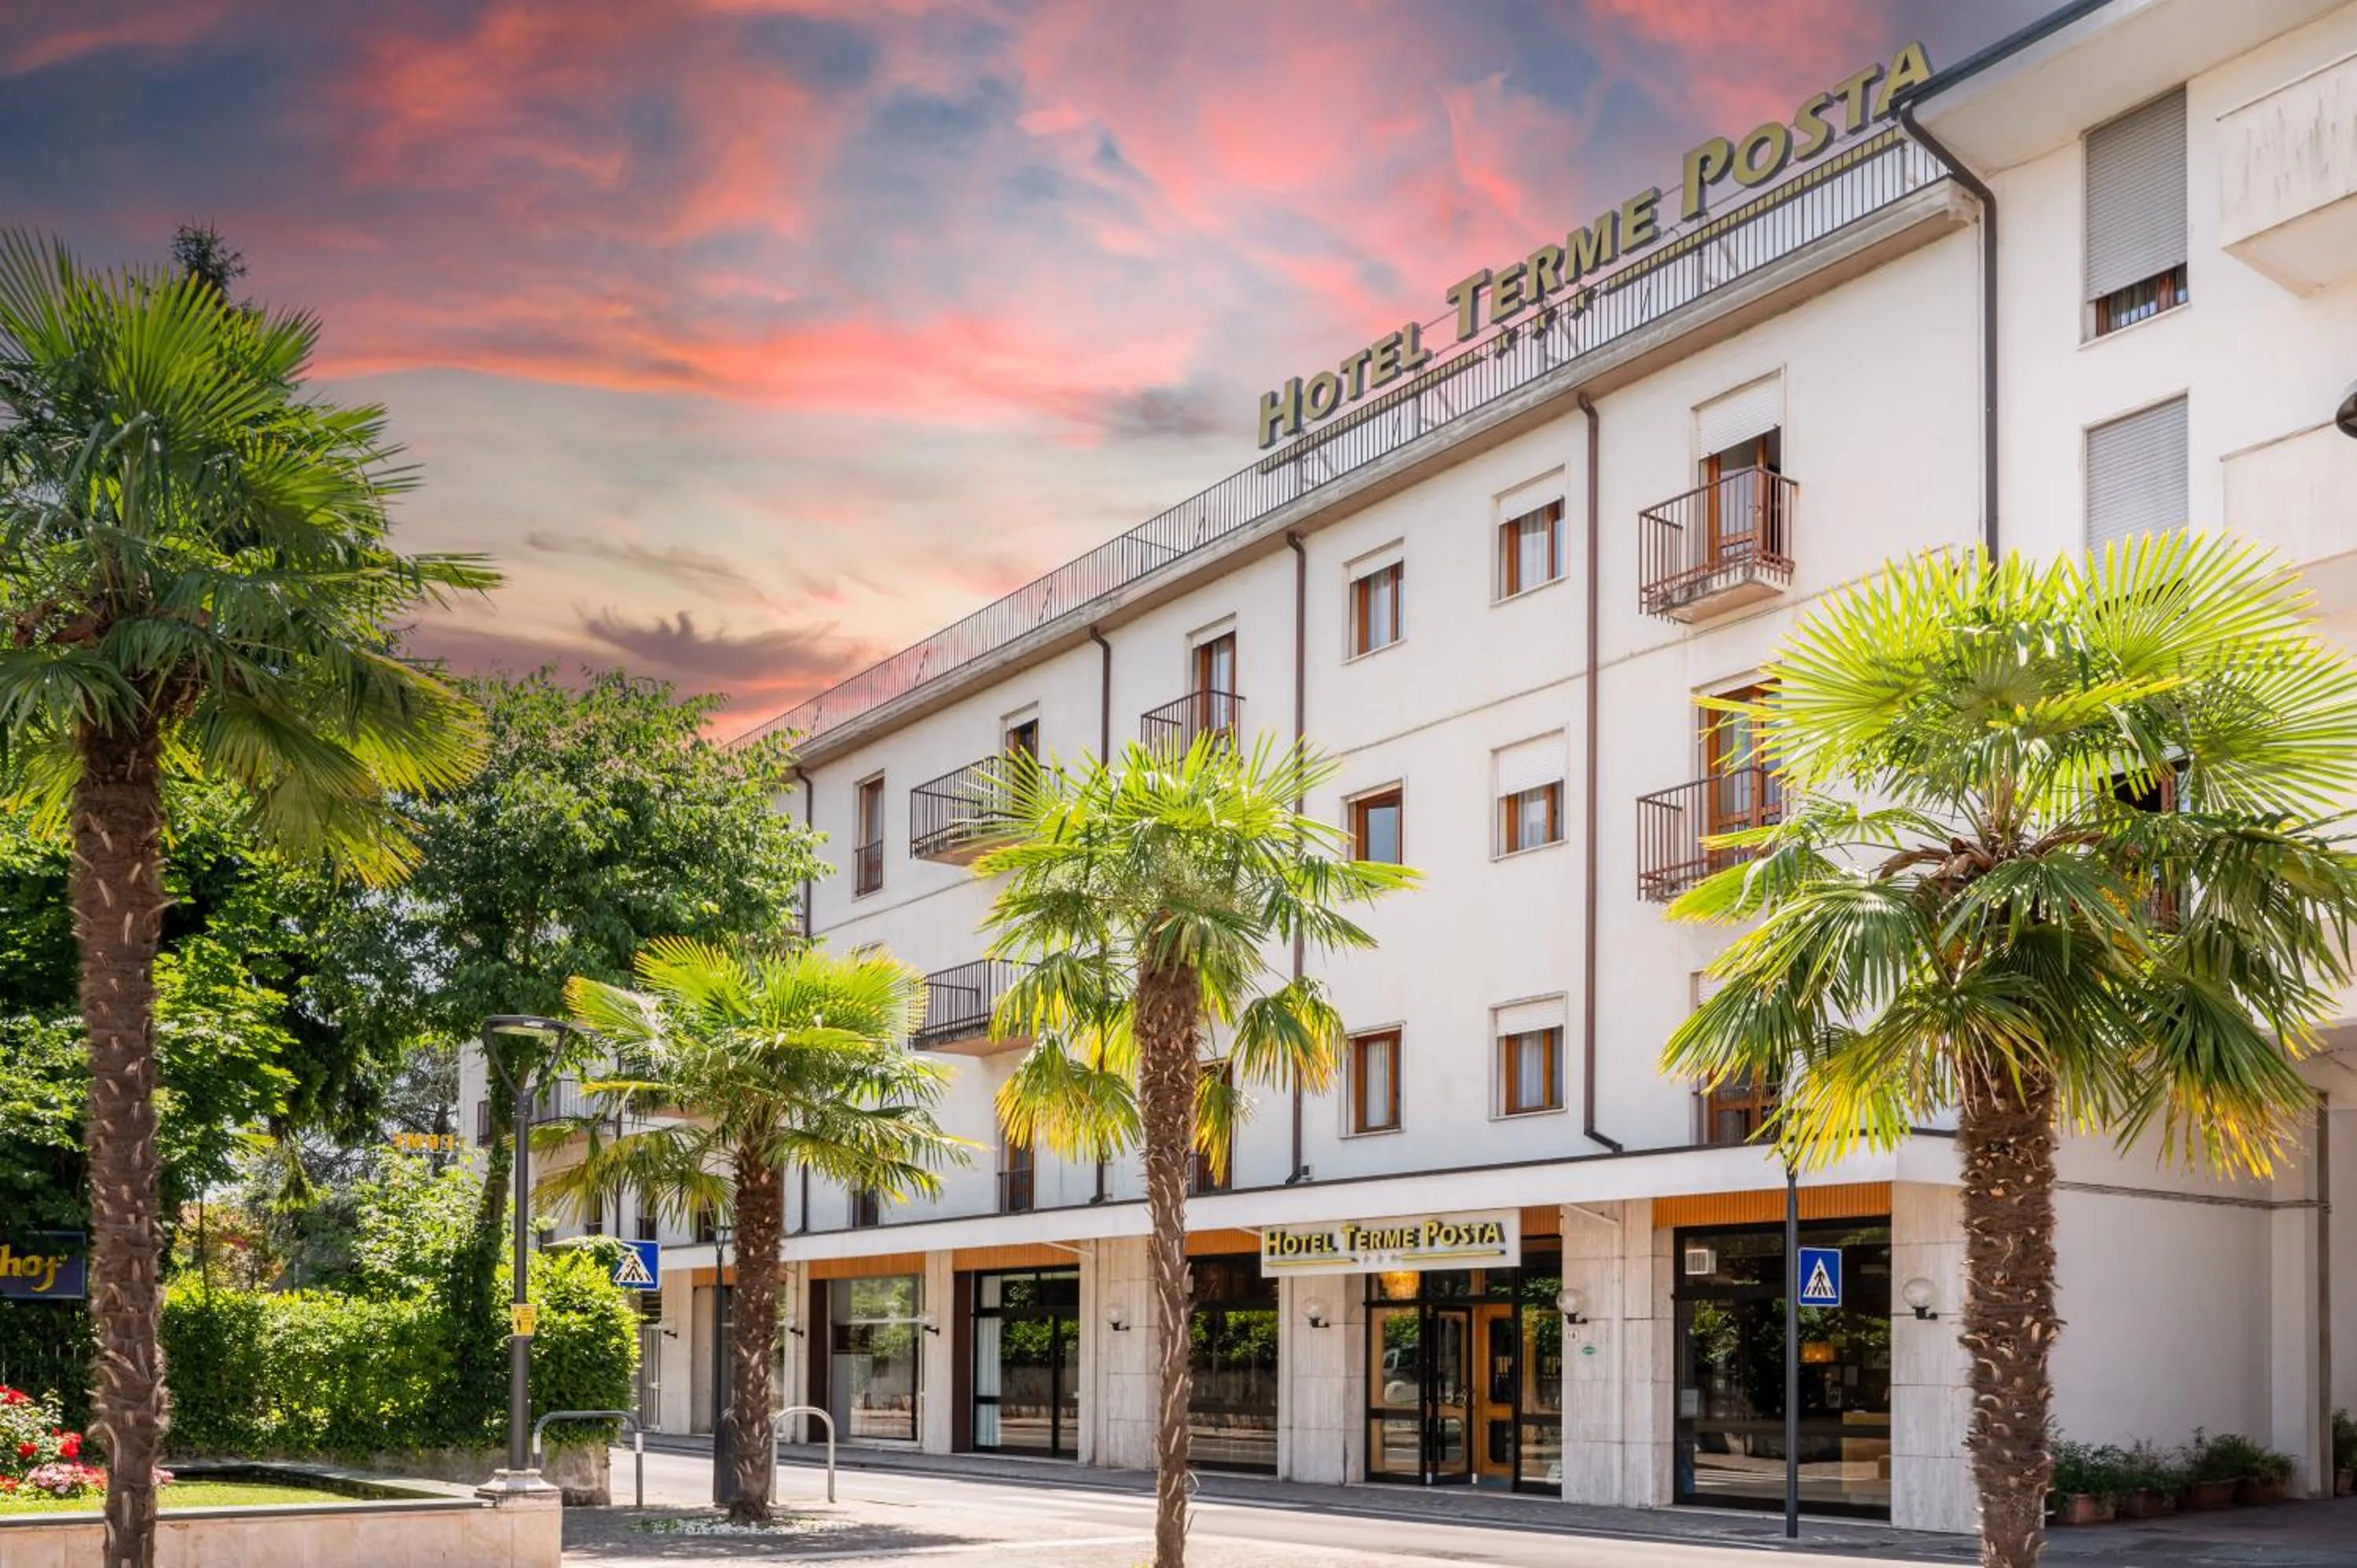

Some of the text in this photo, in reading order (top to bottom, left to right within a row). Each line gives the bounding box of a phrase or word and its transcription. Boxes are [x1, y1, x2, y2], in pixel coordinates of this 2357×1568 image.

[1259, 40, 1934, 449] HOTEL TERME POSTA
[1264, 1219, 1505, 1255] HOTEL TERME POSTA
